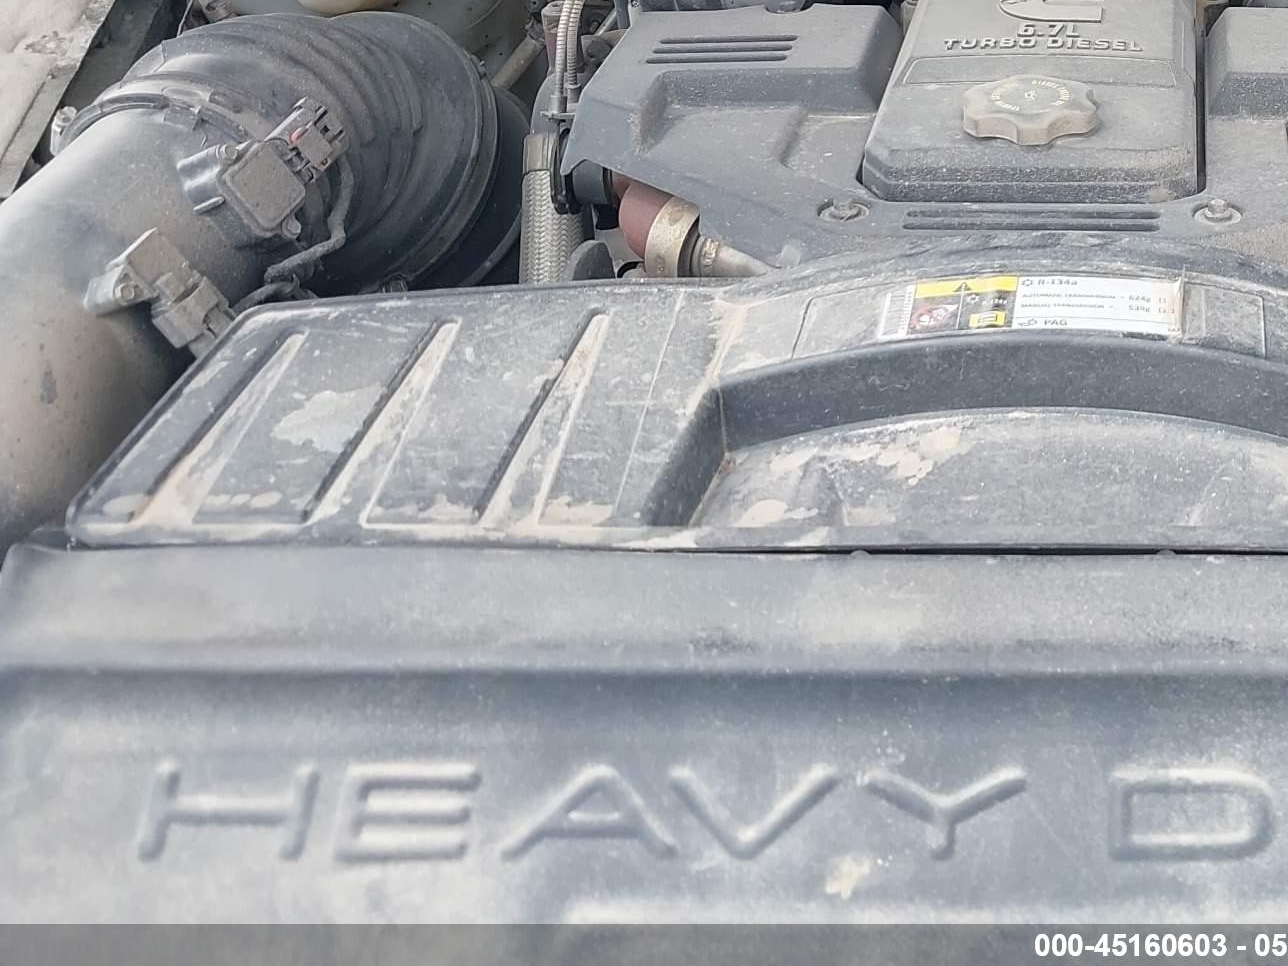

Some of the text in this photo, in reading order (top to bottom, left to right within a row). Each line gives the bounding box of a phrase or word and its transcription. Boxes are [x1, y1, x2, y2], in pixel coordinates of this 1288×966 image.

[1016, 22, 1080, 38] 6.7L
[944, 38, 1144, 52] TURBO DIESEL
[1043, 319, 1068, 327] PAG
[136, 757, 1027, 864] HEAVY
